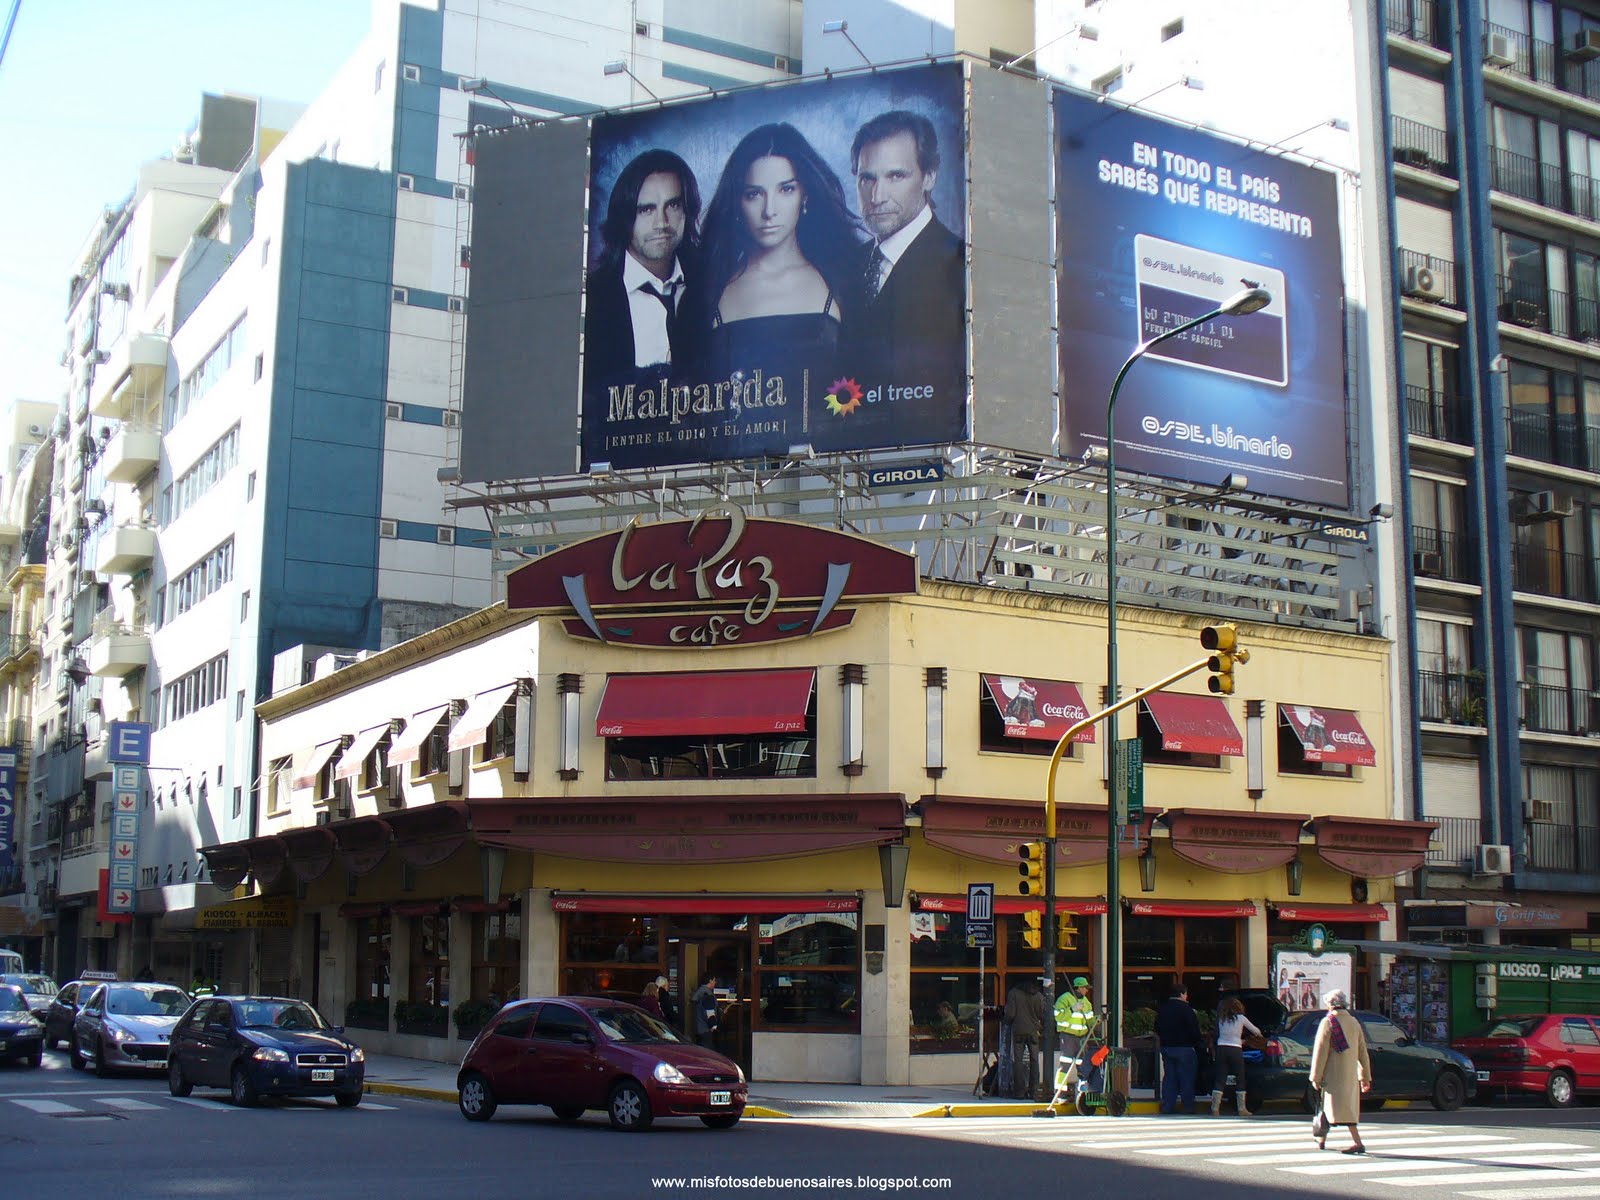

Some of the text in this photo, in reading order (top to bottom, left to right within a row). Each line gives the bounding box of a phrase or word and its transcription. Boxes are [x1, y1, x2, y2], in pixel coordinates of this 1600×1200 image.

[1133, 142, 1280, 203] EN TODO EL PAÍS
[1099, 159, 1312, 237] SABÉS QUÉ REPRESENTA
[606, 368, 787, 425] Malparida
[866, 384, 934, 403] el trece
[612, 420, 780, 447] ENTRE EL ODIO Y EL AMOR
[872, 467, 939, 484] GIROLA
[1323, 524, 1368, 541] GIROLA
[612, 500, 781, 625] La Paz
[774, 720, 801, 732] La paz
[119, 729, 141, 756] E
[1080, 733, 1093, 742] paz
[1222, 745, 1230, 753] La
[120, 770, 135, 787] E
[118, 818, 133, 834] E
[116, 866, 131, 882] E
[203, 910, 236, 918] KIOSCO
[1511, 910, 1535, 922] Griff
[1500, 963, 1540, 976] KIOSCO
[1559, 965, 1582, 978] PAZ
